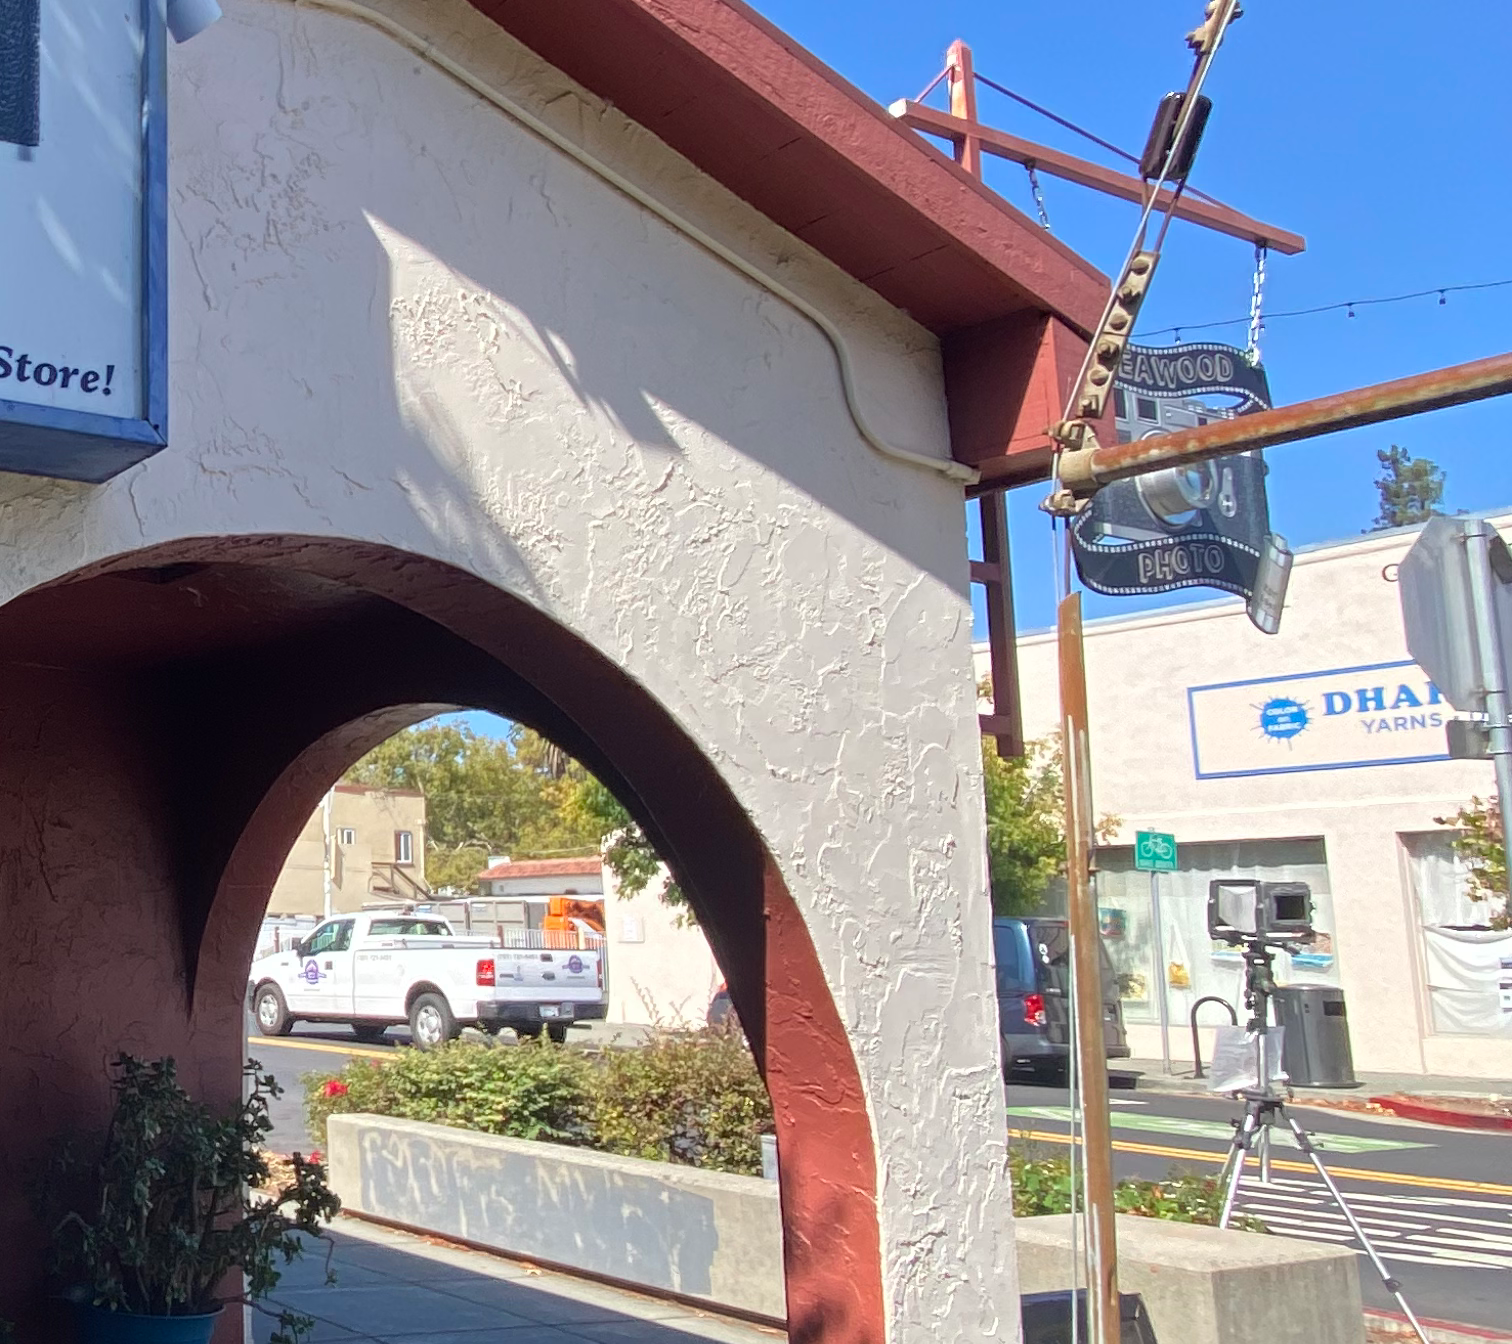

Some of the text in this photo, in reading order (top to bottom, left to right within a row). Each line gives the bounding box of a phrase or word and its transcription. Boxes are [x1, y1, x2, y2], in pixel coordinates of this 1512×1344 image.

[1116, 351, 1234, 389] EAWOOD
[1138, 543, 1224, 584] PHOTO
[1361, 713, 1444, 734] YARNS
